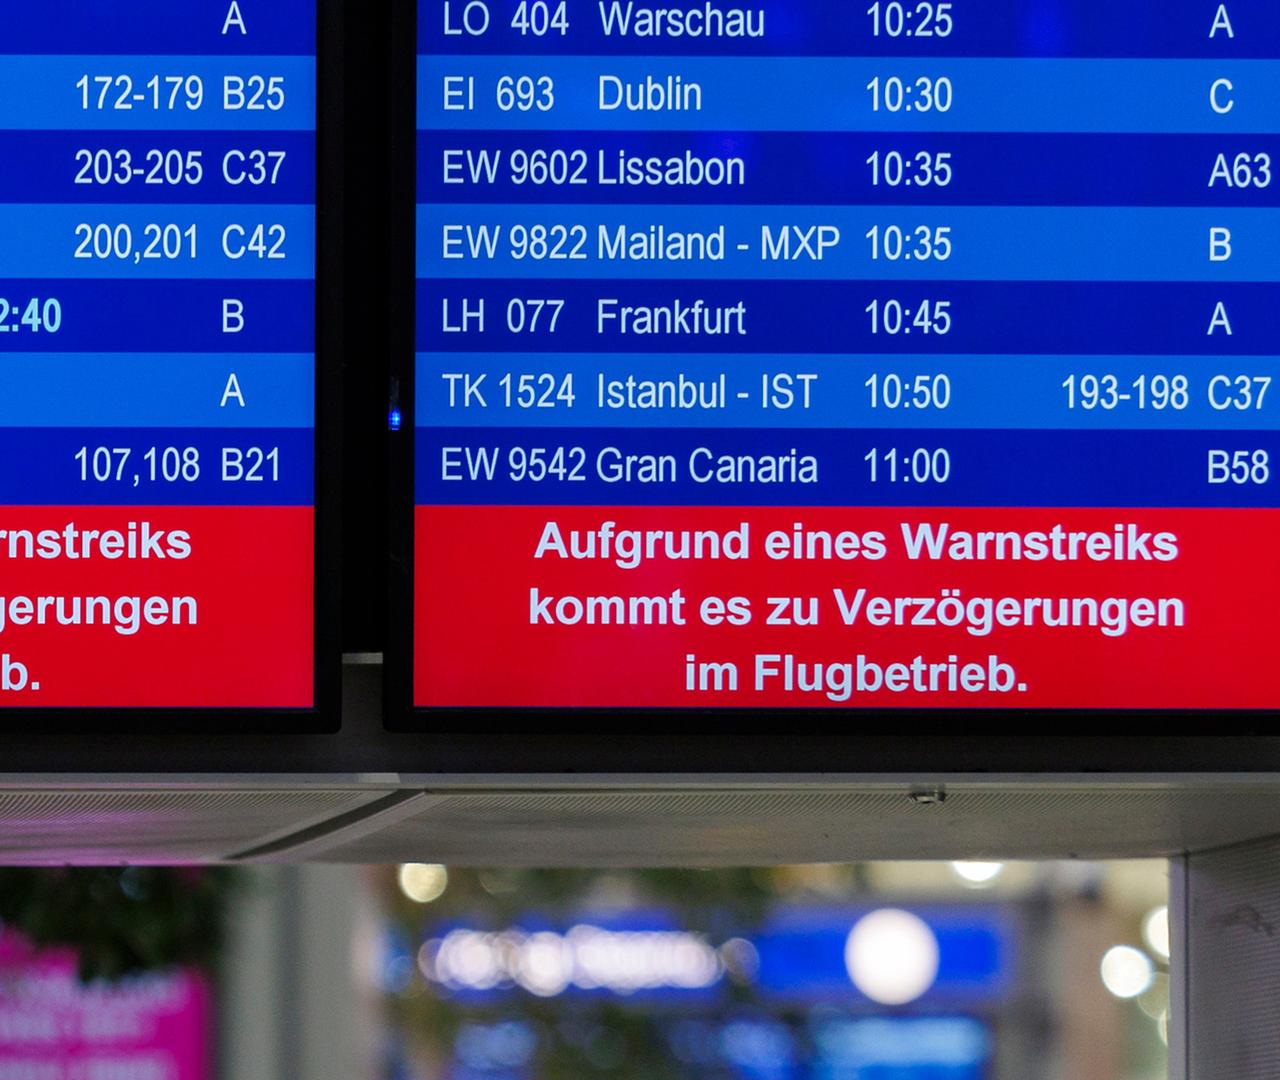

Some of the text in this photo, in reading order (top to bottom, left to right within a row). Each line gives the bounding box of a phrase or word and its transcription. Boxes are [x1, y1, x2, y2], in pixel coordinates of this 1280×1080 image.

[444, 0, 1234, 38] LO 404 Warschau 10:25 A
[76, 74, 204, 111] 172-179
[223, 75, 285, 111] B25
[443, 75, 1234, 114] EI 693 Dublin 10:30 C
[74, 149, 203, 185] 203-205
[222, 149, 286, 185] C37
[443, 149, 1271, 188] EW 9602 Lissabon 10:35 A63
[74, 223, 196, 264] 200,201
[222, 223, 286, 259] C42
[222, 298, 244, 333] B
[442, 298, 1232, 335] LH 077 Frankfurt 10:45 A
[220, 373, 245, 407] A
[442, 446, 1270, 484] EW 9542 Gran Canaria 11:00 B58
[533, 520, 1179, 570] Aufgrund eines Warnstreiks
[529, 587, 1184, 637] kommt es zu Verzögerungen
[686, 653, 1027, 702] im Flugbetrieb.
